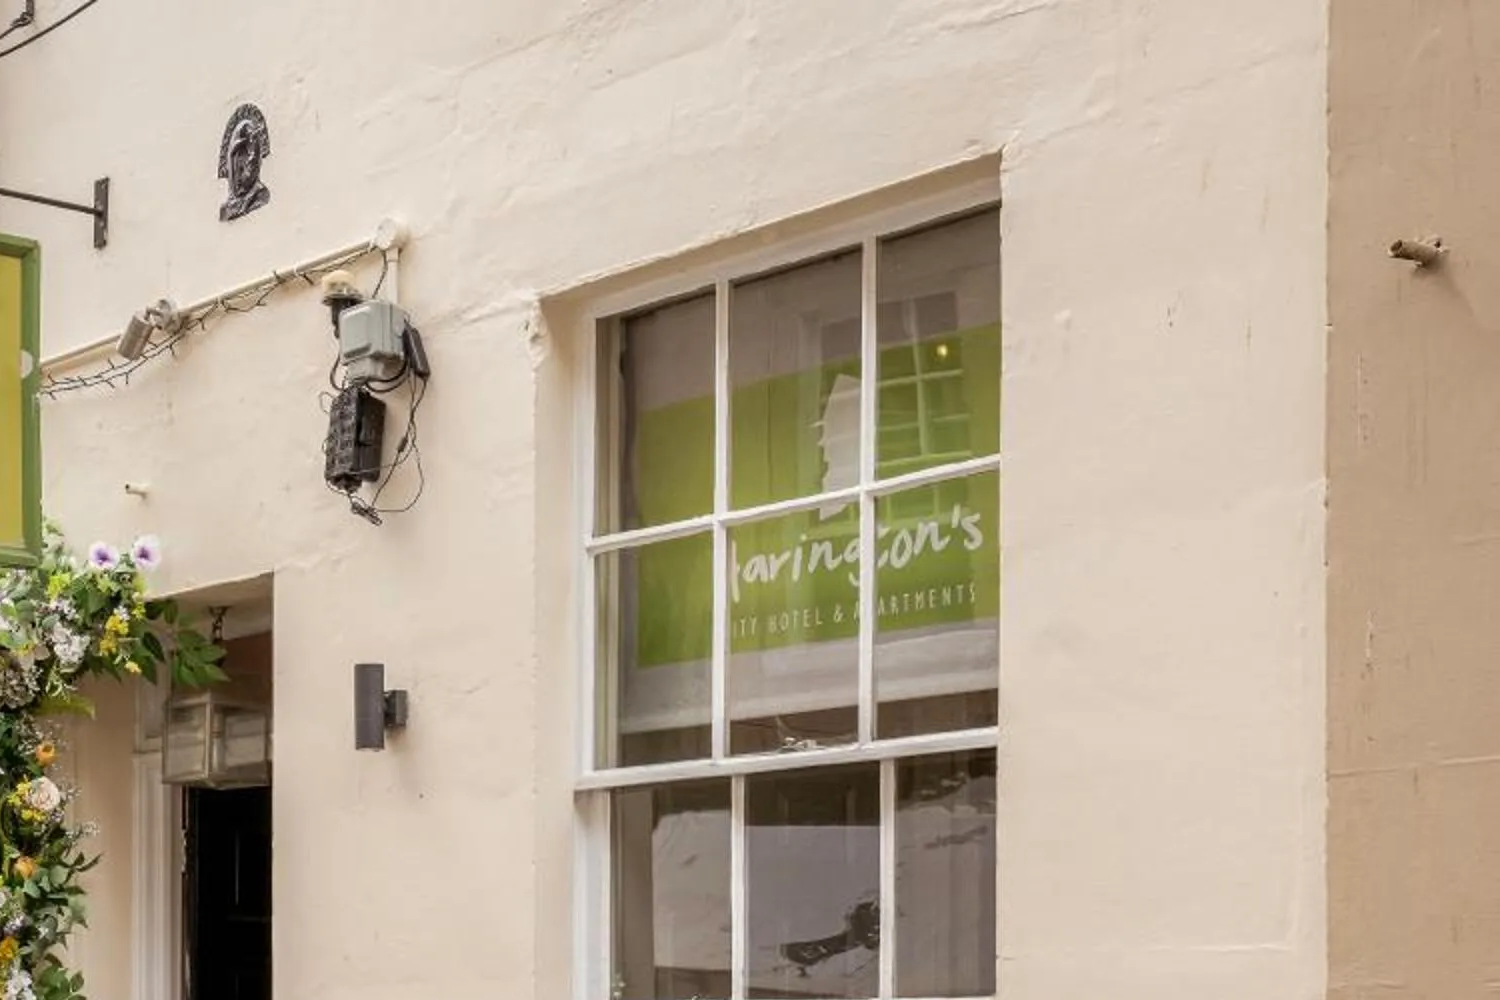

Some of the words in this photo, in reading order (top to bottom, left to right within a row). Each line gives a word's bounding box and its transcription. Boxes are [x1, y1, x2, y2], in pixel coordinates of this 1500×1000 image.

[732, 617, 758, 639] ITY
[768, 606, 823, 633] HOTEL
[833, 603, 844, 623] &
[853, 583, 976, 621] AARTMENTS
